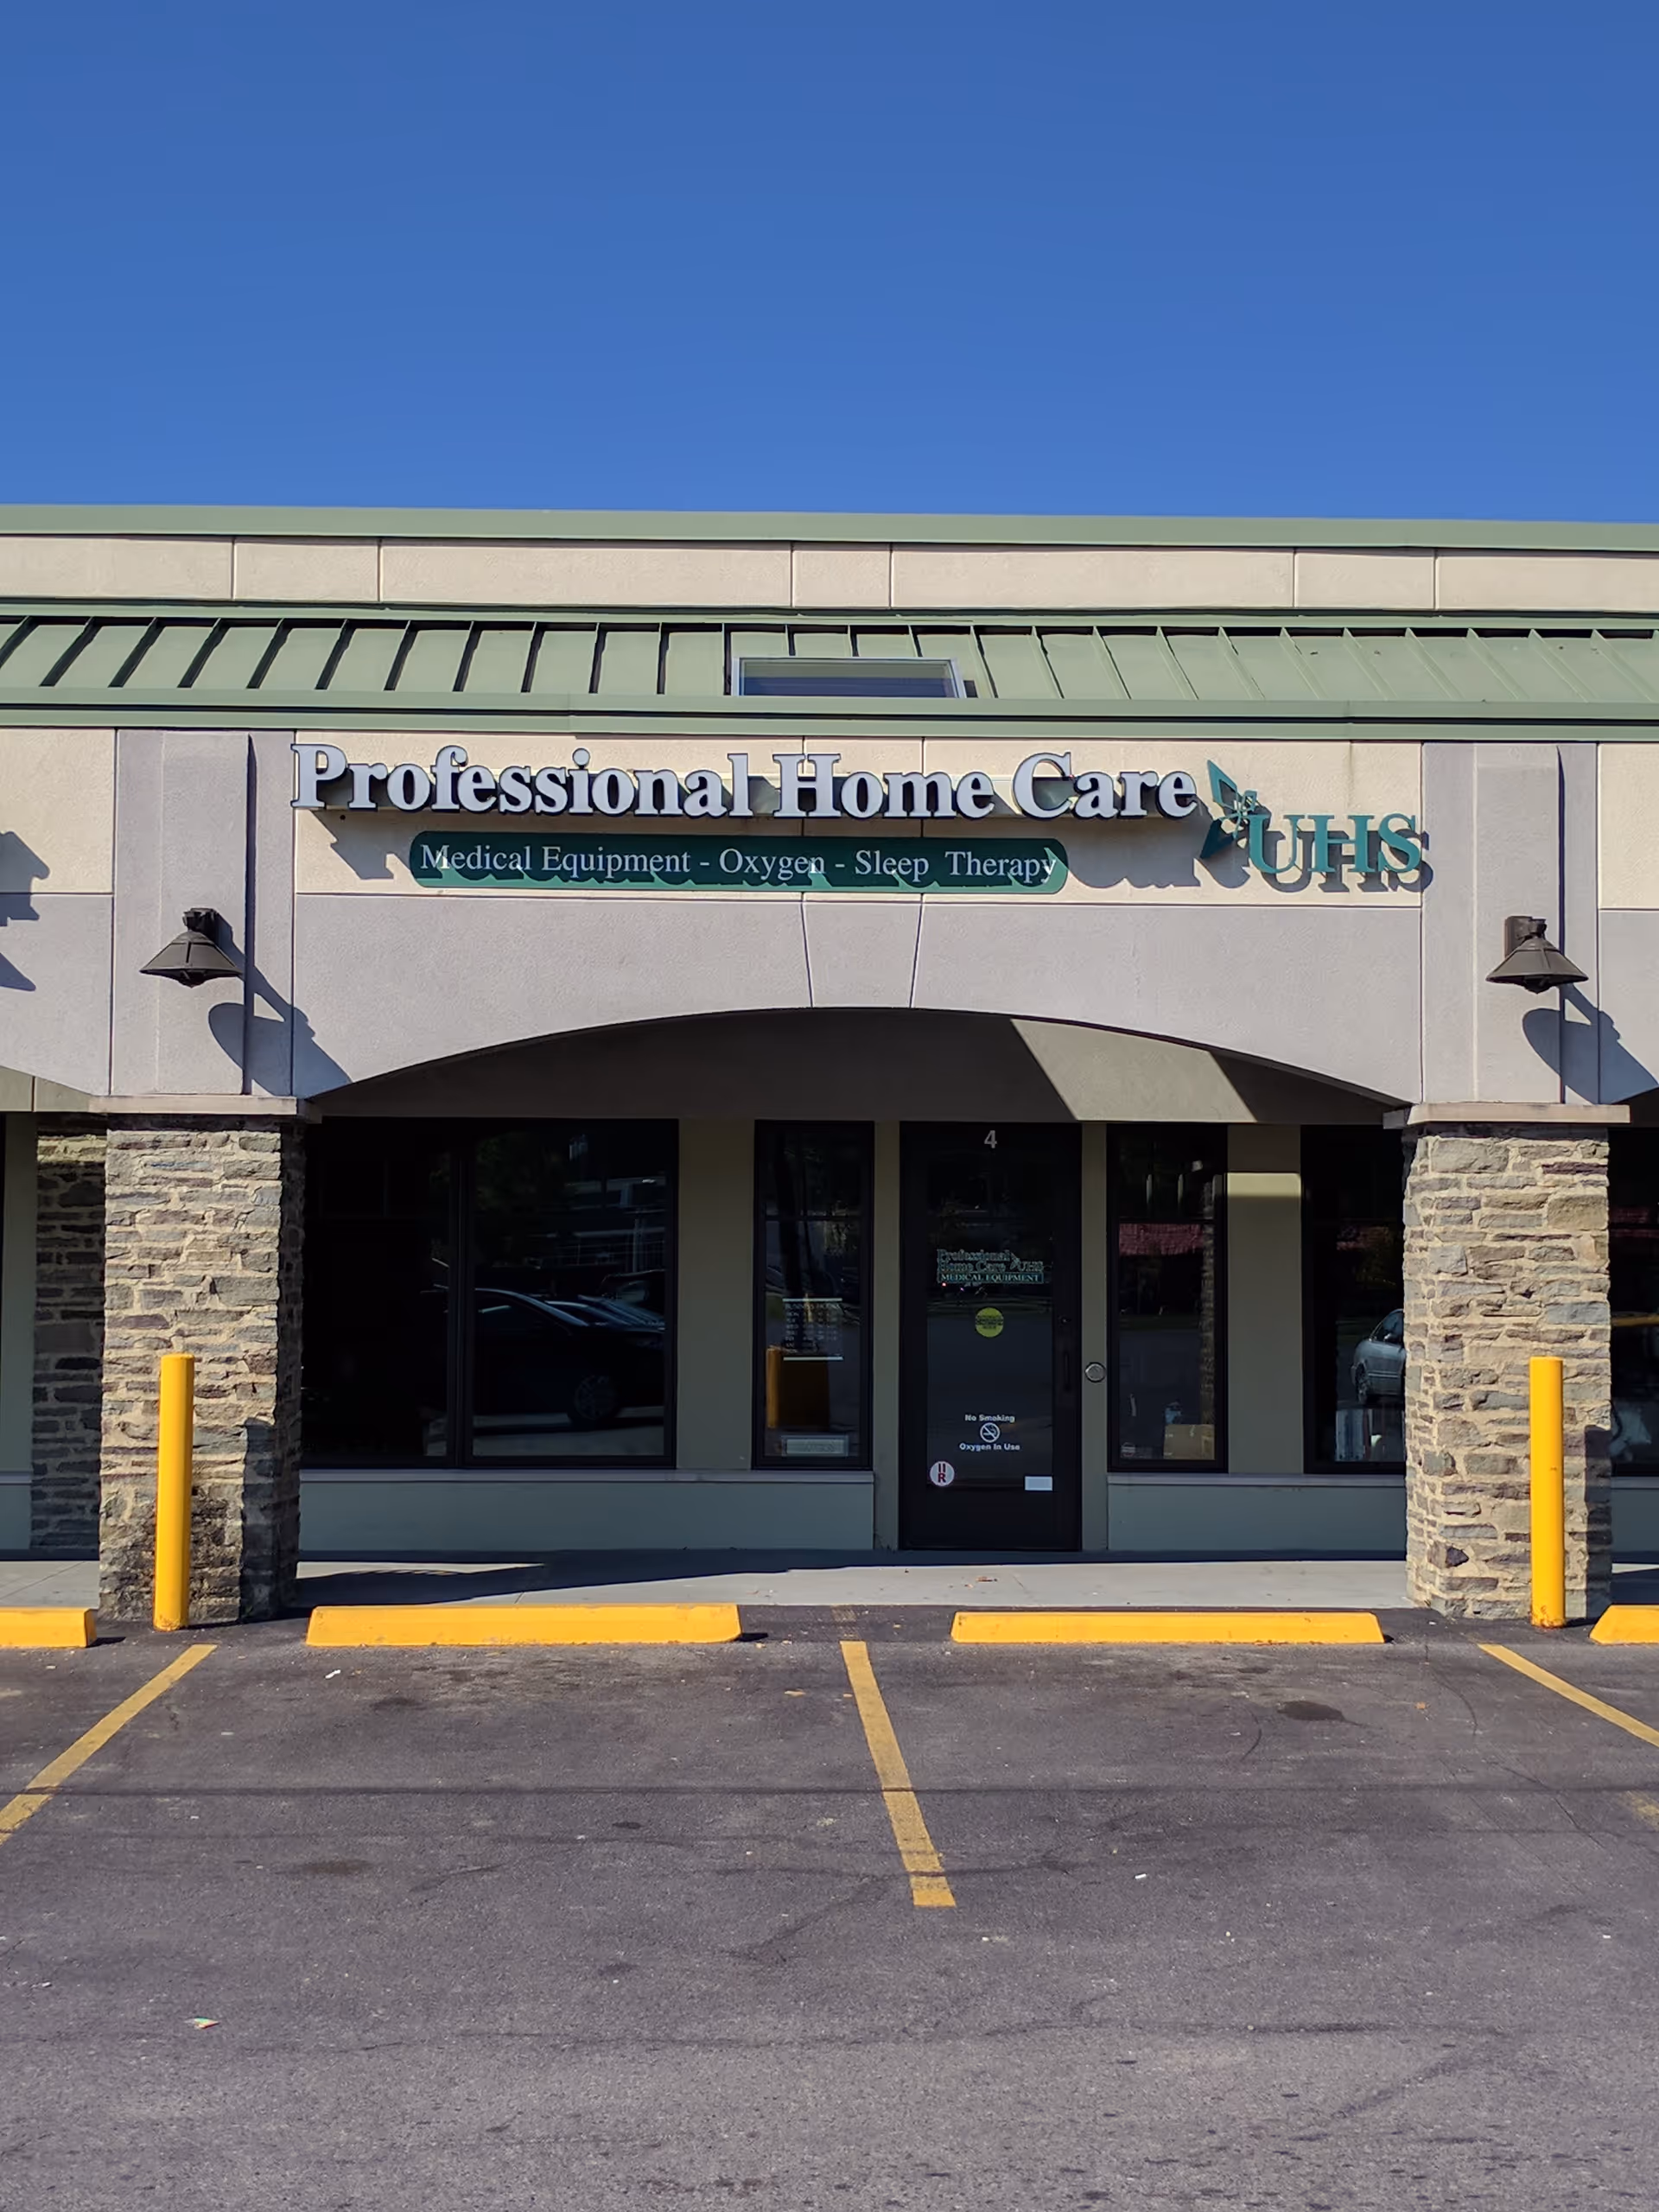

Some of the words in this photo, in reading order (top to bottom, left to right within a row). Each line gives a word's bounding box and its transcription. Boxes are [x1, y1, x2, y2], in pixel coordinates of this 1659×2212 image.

[290, 742, 754, 818] Professional
[772, 753, 995, 820] Home
[1014, 752, 1198, 820] Care
[1245, 813, 1422, 874] UHS
[421, 844, 534, 872] Medical
[541, 846, 690, 878] Equipment
[719, 848, 825, 881] Oxygen
[855, 849, 930, 882] Sleep
[944, 850, 1057, 884] Therapy
[984, 1130, 997, 1148] 4
[979, 1414, 1015, 1423] Smoking
[959, 1443, 991, 1452] Oxygen
[938, 1473, 946, 1483] R
